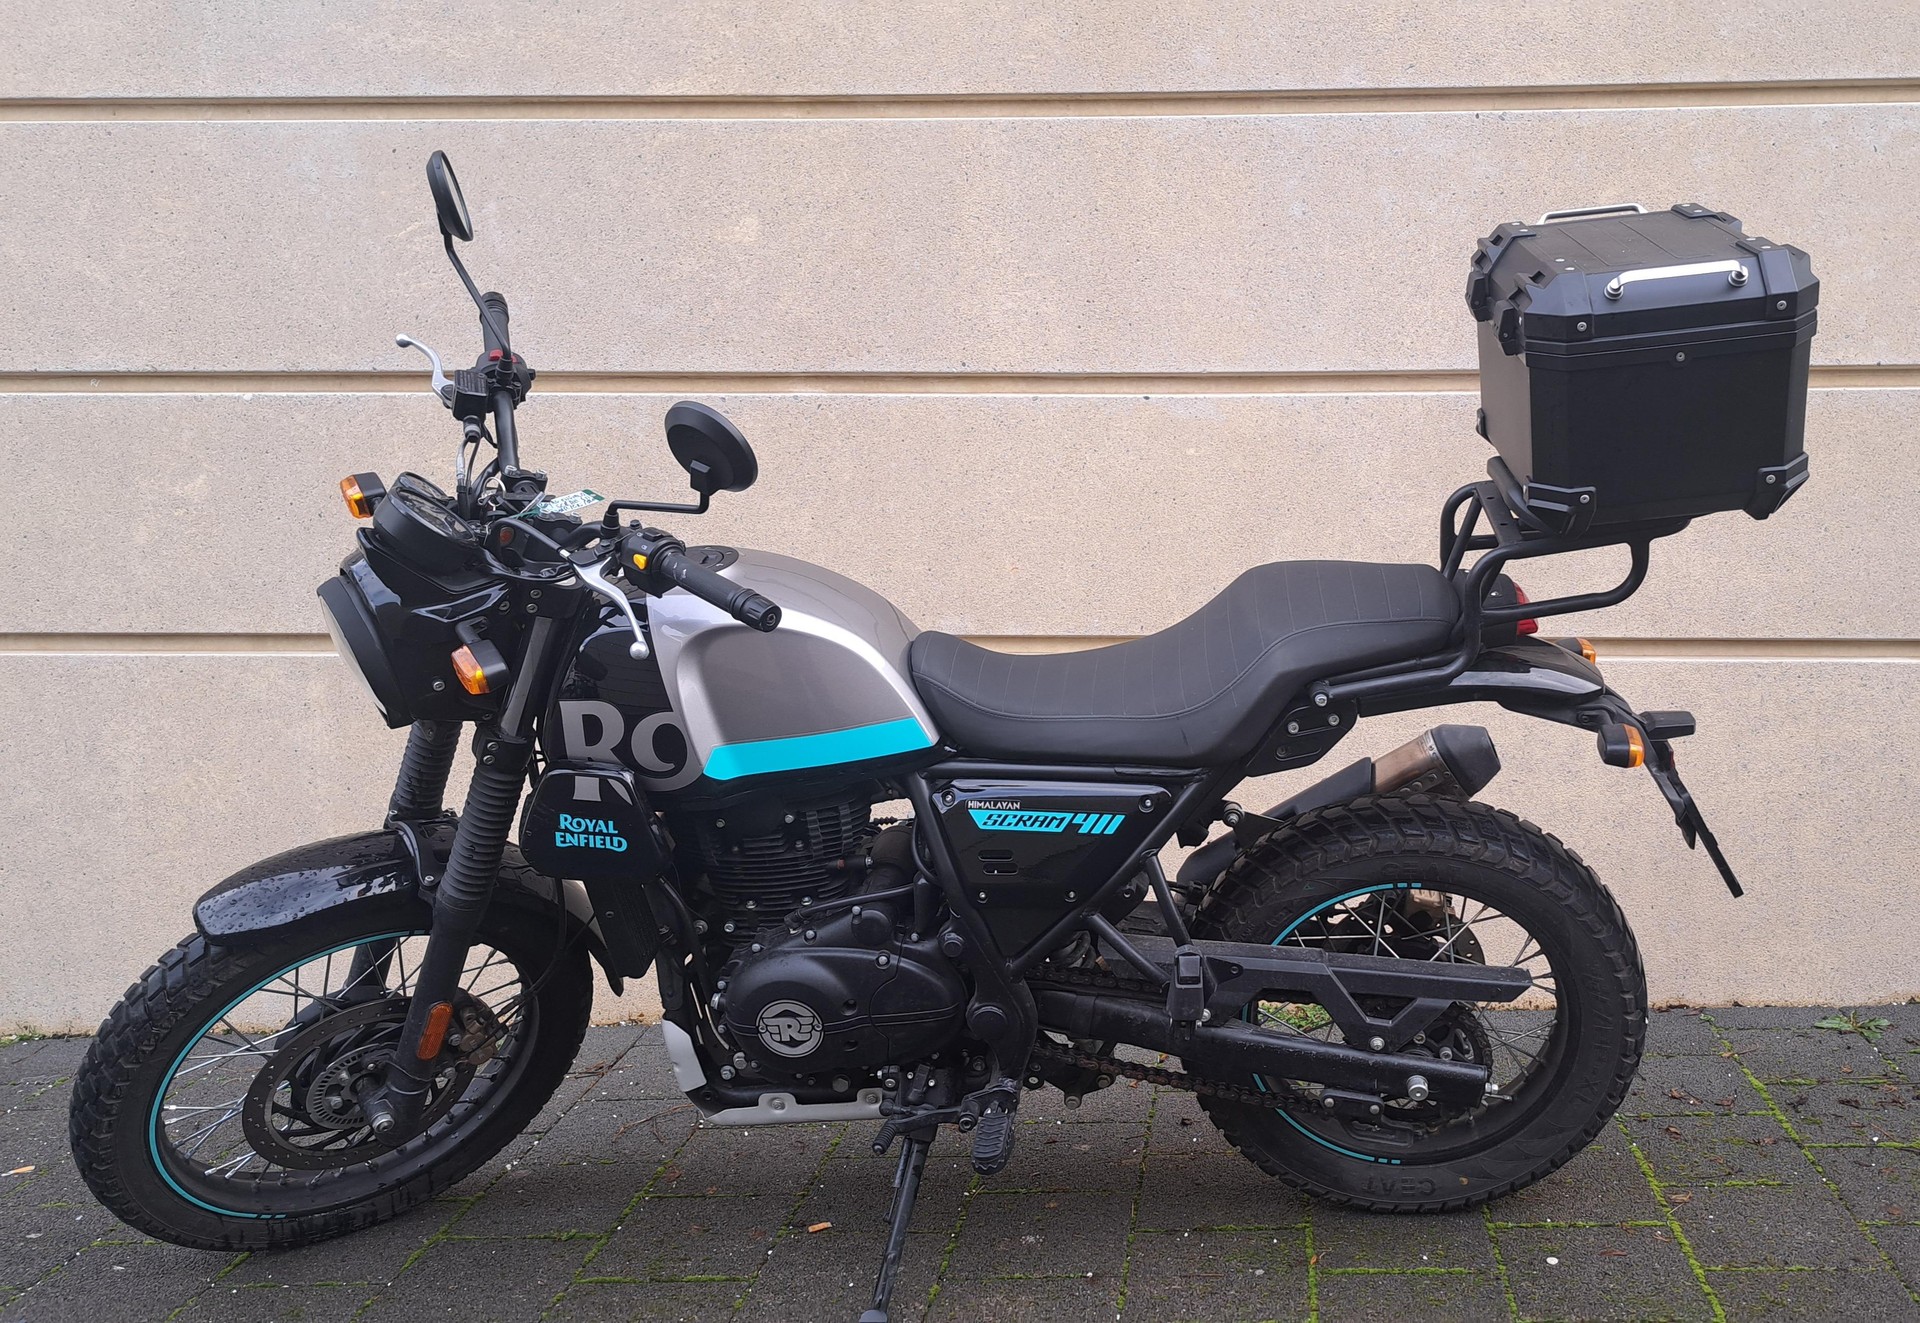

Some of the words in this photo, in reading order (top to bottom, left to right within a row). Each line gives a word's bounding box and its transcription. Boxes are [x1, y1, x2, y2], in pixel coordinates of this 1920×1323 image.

[967, 800, 1021, 810] HIMALAYAN
[559, 813, 619, 834] ROYAL
[982, 813, 1068, 829] SCRAM
[1071, 812, 1127, 835] 411
[554, 831, 628, 852] ENFIELD
[1360, 1175, 1437, 1197] CEAT
